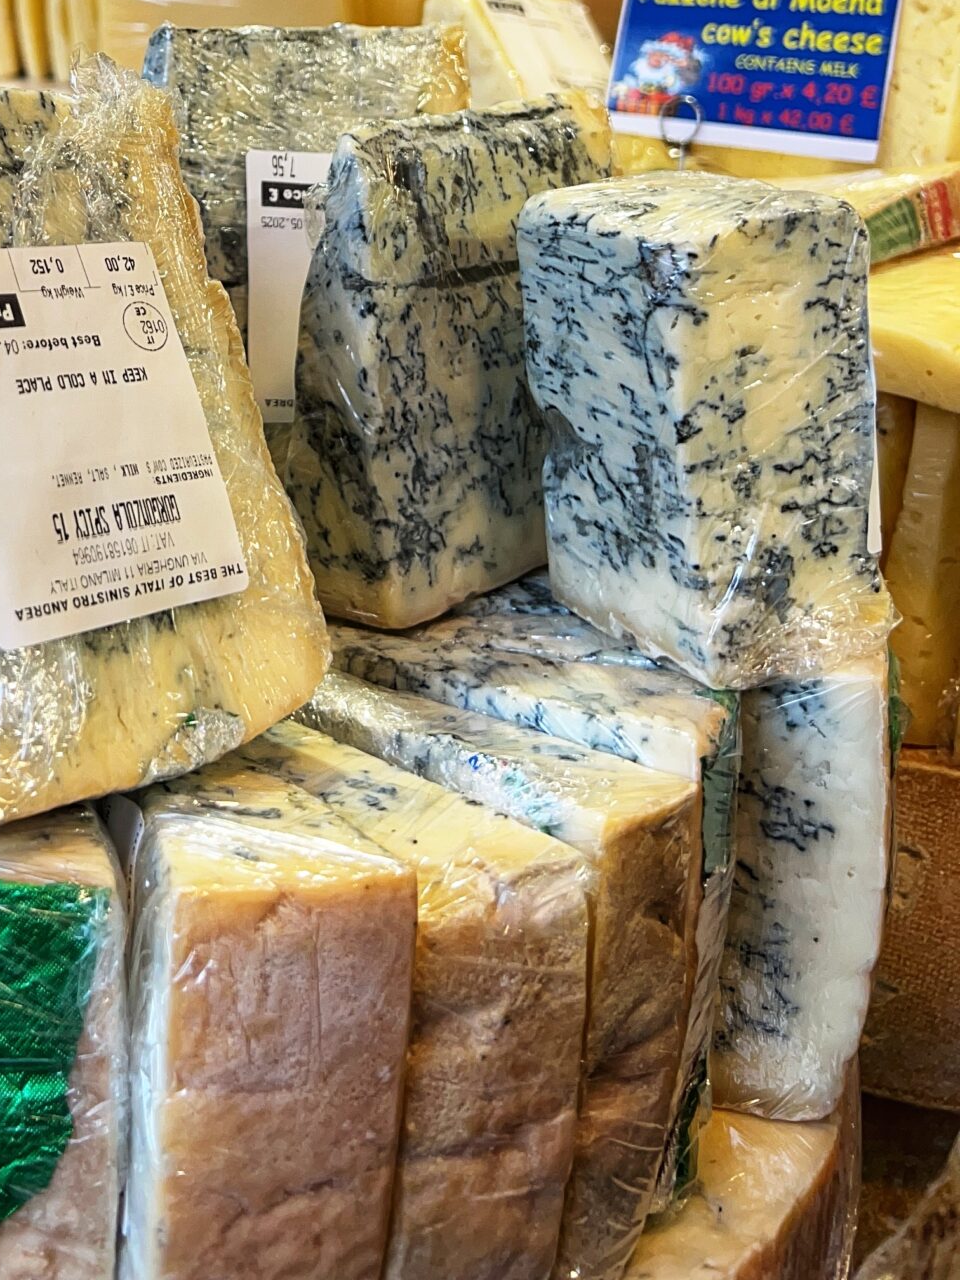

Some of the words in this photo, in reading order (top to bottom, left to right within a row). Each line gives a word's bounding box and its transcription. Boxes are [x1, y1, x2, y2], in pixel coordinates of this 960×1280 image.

[701, 17, 773, 49] cow's
[783, 21, 885, 56] cheese
[819, 61, 859, 79] MILK
[708, 72, 745, 94] 100
[802, 81, 854, 106] 4,20
[860, 84, 879, 109] €
[719, 102, 728, 120] 1
[734, 104, 756, 126] kg
[761, 110, 773, 124] x
[778, 108, 833, 131] 42,00
[840, 114, 855, 135] €
[271, 153, 296, 178] 7,56
[268, 187, 279, 203] £
[30, 256, 64, 275] 0,152
[105, 255, 135, 272] 42,00
[41, 285, 53, 299] kg
[53, 286, 85, 299] Weight
[135, 284, 155, 297] Price
[134, 306, 147, 316] CE
[140, 320, 165, 334] 0162
[23, 337, 68, 351] before:
[73, 334, 101, 348] Best
[147, 335, 155, 345] IT
[59, 372, 85, 389] COLD
[89, 371, 97, 386] A
[102, 368, 117, 385] IN
[123, 366, 148, 382] KEEP
[16, 375, 52, 395] PLACE
[264, 399, 295, 408] DREA
[120, 463, 139, 477] MILK
[170, 453, 213, 470] PASTEURIZED
[153, 468, 214, 485] INGREDIENTS:
[73, 505, 111, 539] SPICY
[112, 494, 181, 533] GORGONZOLA
[52, 512, 70, 544] 15
[72, 539, 139, 566] 06158190964
[142, 538, 149, 552] IT
[137, 556, 189, 577] UNGHERIA
[191, 551, 208, 565] VIA
[81, 568, 122, 588] MILANO
[125, 566, 135, 578] 11
[189, 566, 217, 584] BEST
[221, 562, 243, 577] THE
[50, 576, 78, 595] ITALY
[135, 579, 165, 596] ITALY
[169, 575, 184, 587] OF
[73, 584, 130, 609] SINISTRO
[15, 599, 69, 621] ANDREA
